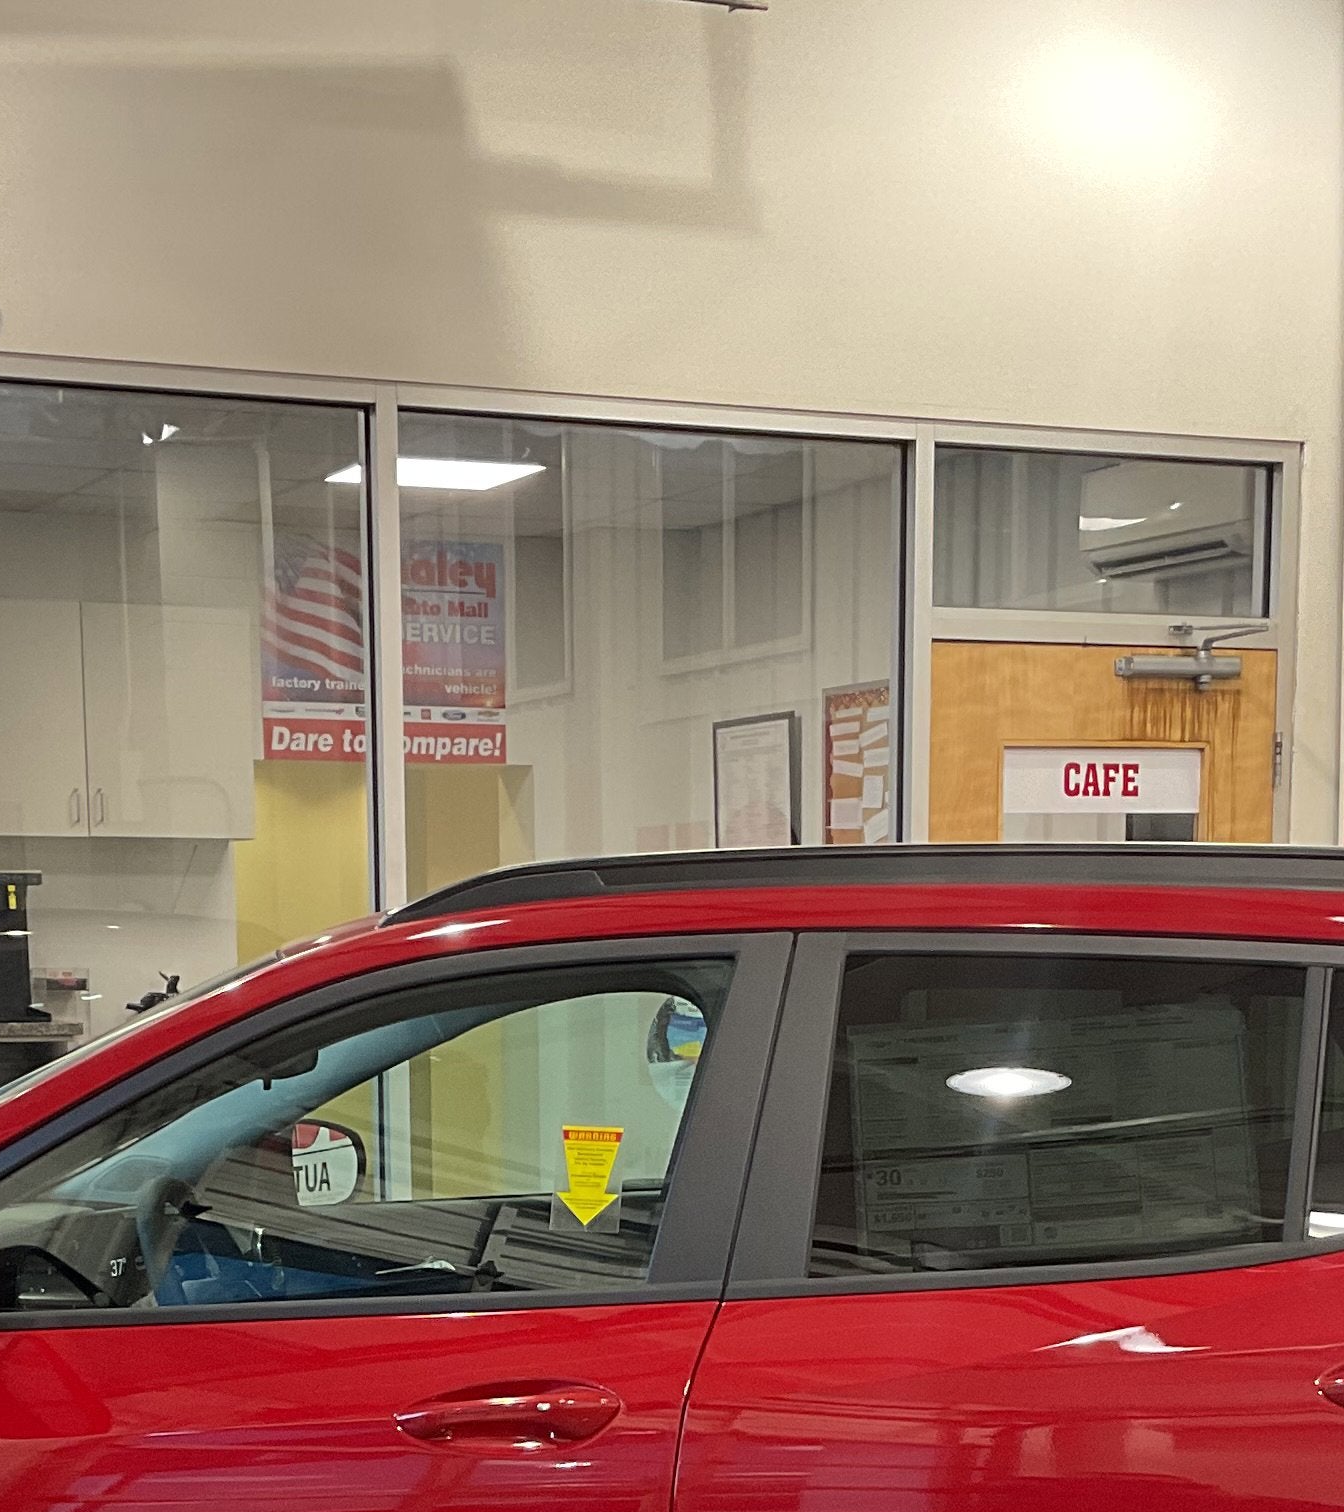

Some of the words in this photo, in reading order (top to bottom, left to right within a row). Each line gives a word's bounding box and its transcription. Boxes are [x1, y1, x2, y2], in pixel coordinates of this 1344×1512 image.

[400, 548, 496, 598] aley
[402, 622, 496, 644] ERVICE
[401, 664, 471, 676] echnicians
[271, 676, 321, 691] factory
[325, 678, 364, 690] traine
[271, 726, 334, 752] Dare
[342, 729, 367, 753] to
[403, 733, 502, 761] ompare!
[1064, 762, 1139, 797] CAFE
[568, 1132, 617, 1142] WARNING
[876, 1169, 902, 1186] 30
